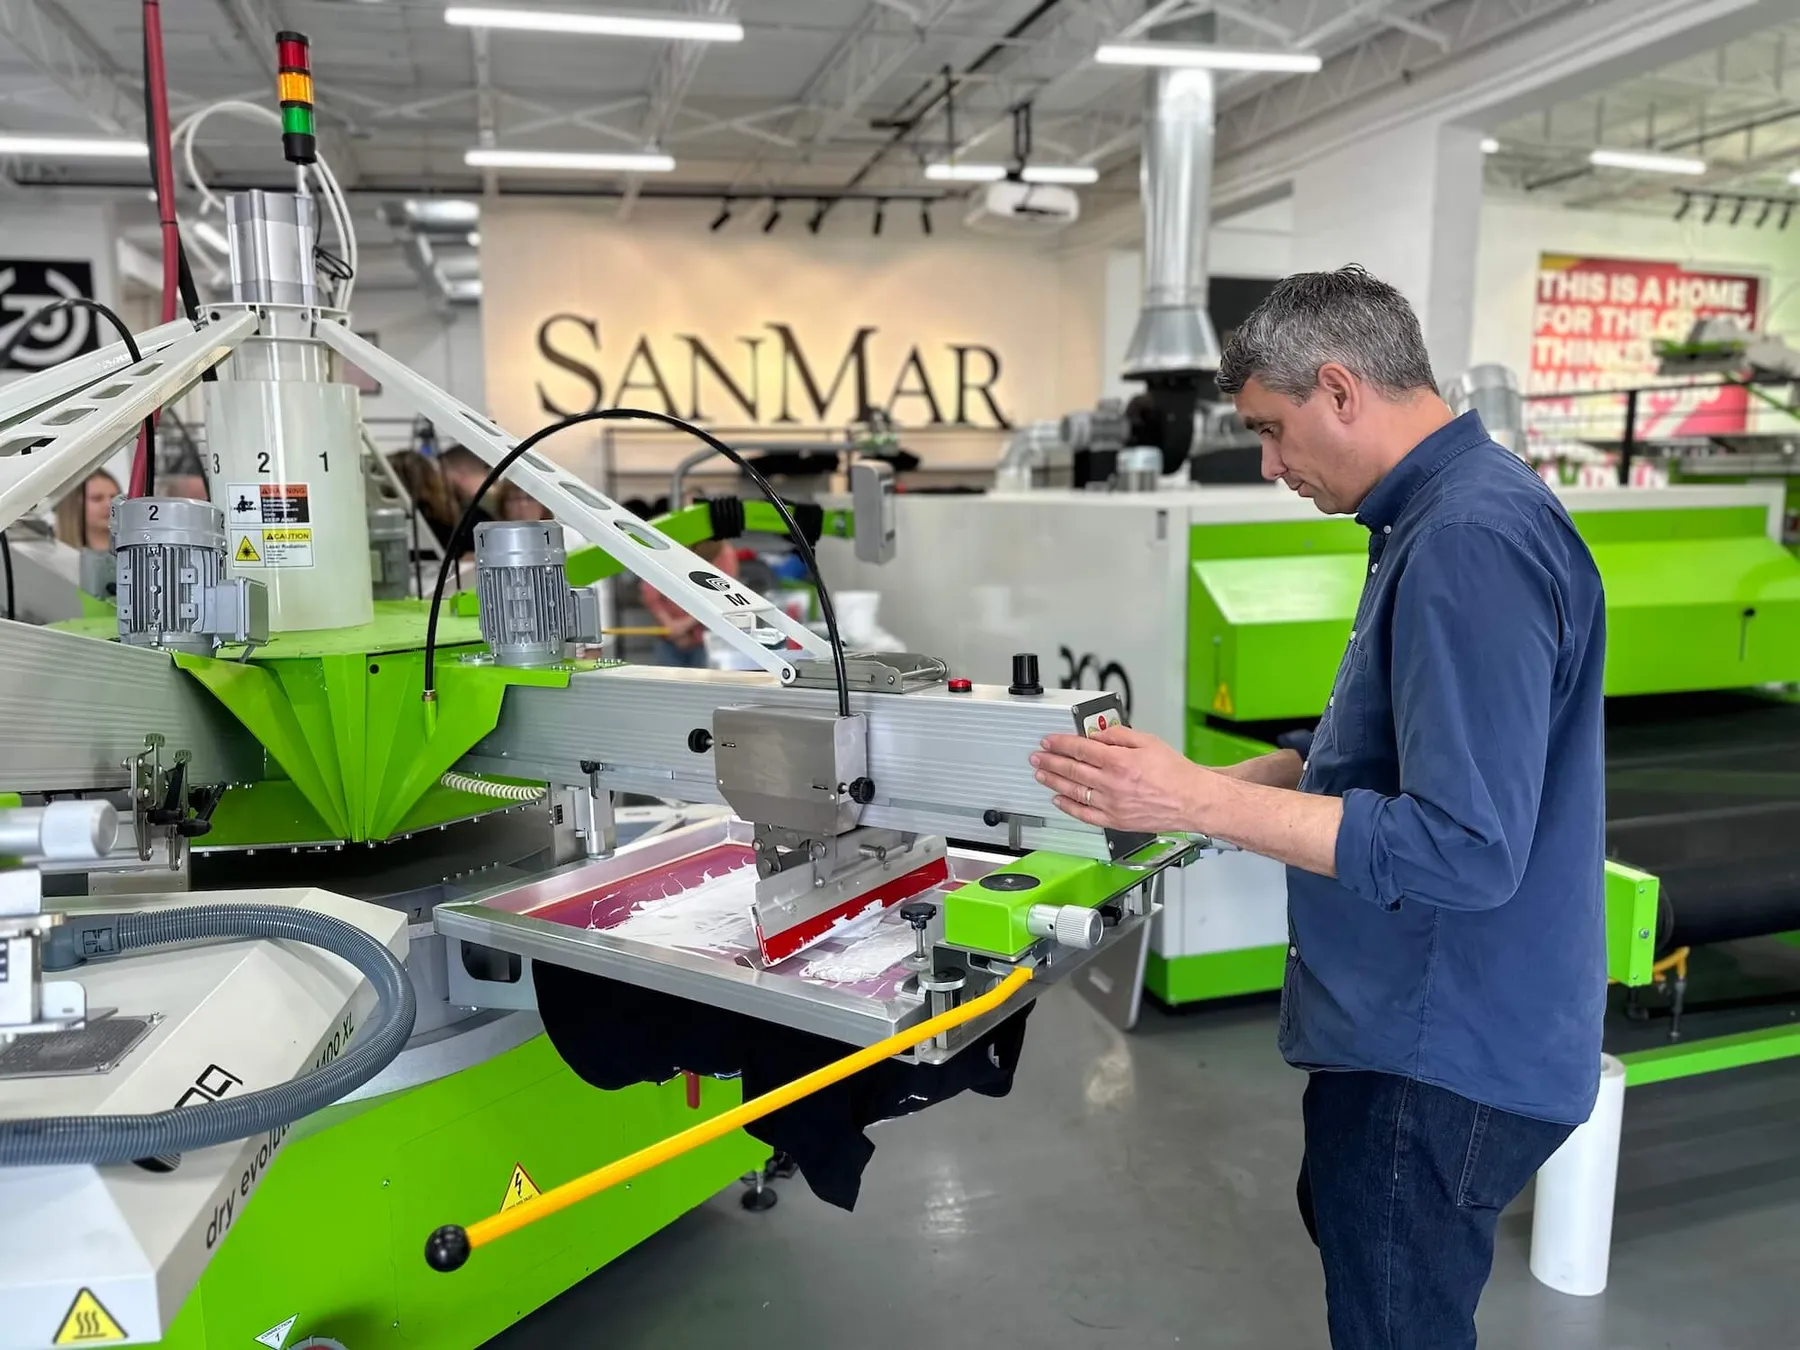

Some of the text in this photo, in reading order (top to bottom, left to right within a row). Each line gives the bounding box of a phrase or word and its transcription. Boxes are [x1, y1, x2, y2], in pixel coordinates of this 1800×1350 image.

[1539, 271, 1747, 310] THIS IS A HOME
[1535, 303, 1593, 336] FOR
[1598, 307, 1656, 341] THE
[212, 453, 221, 474] 3
[257, 452, 270, 473] 2
[319, 451, 329, 472] 1
[271, 486, 306, 495] WANING
[148, 505, 159, 521] 2
[479, 533, 485, 548] 1
[544, 530, 550, 545] 1
[724, 593, 751, 607] M
[206, 1187, 236, 1250] dry
[342, 1011, 355, 1046] XL
